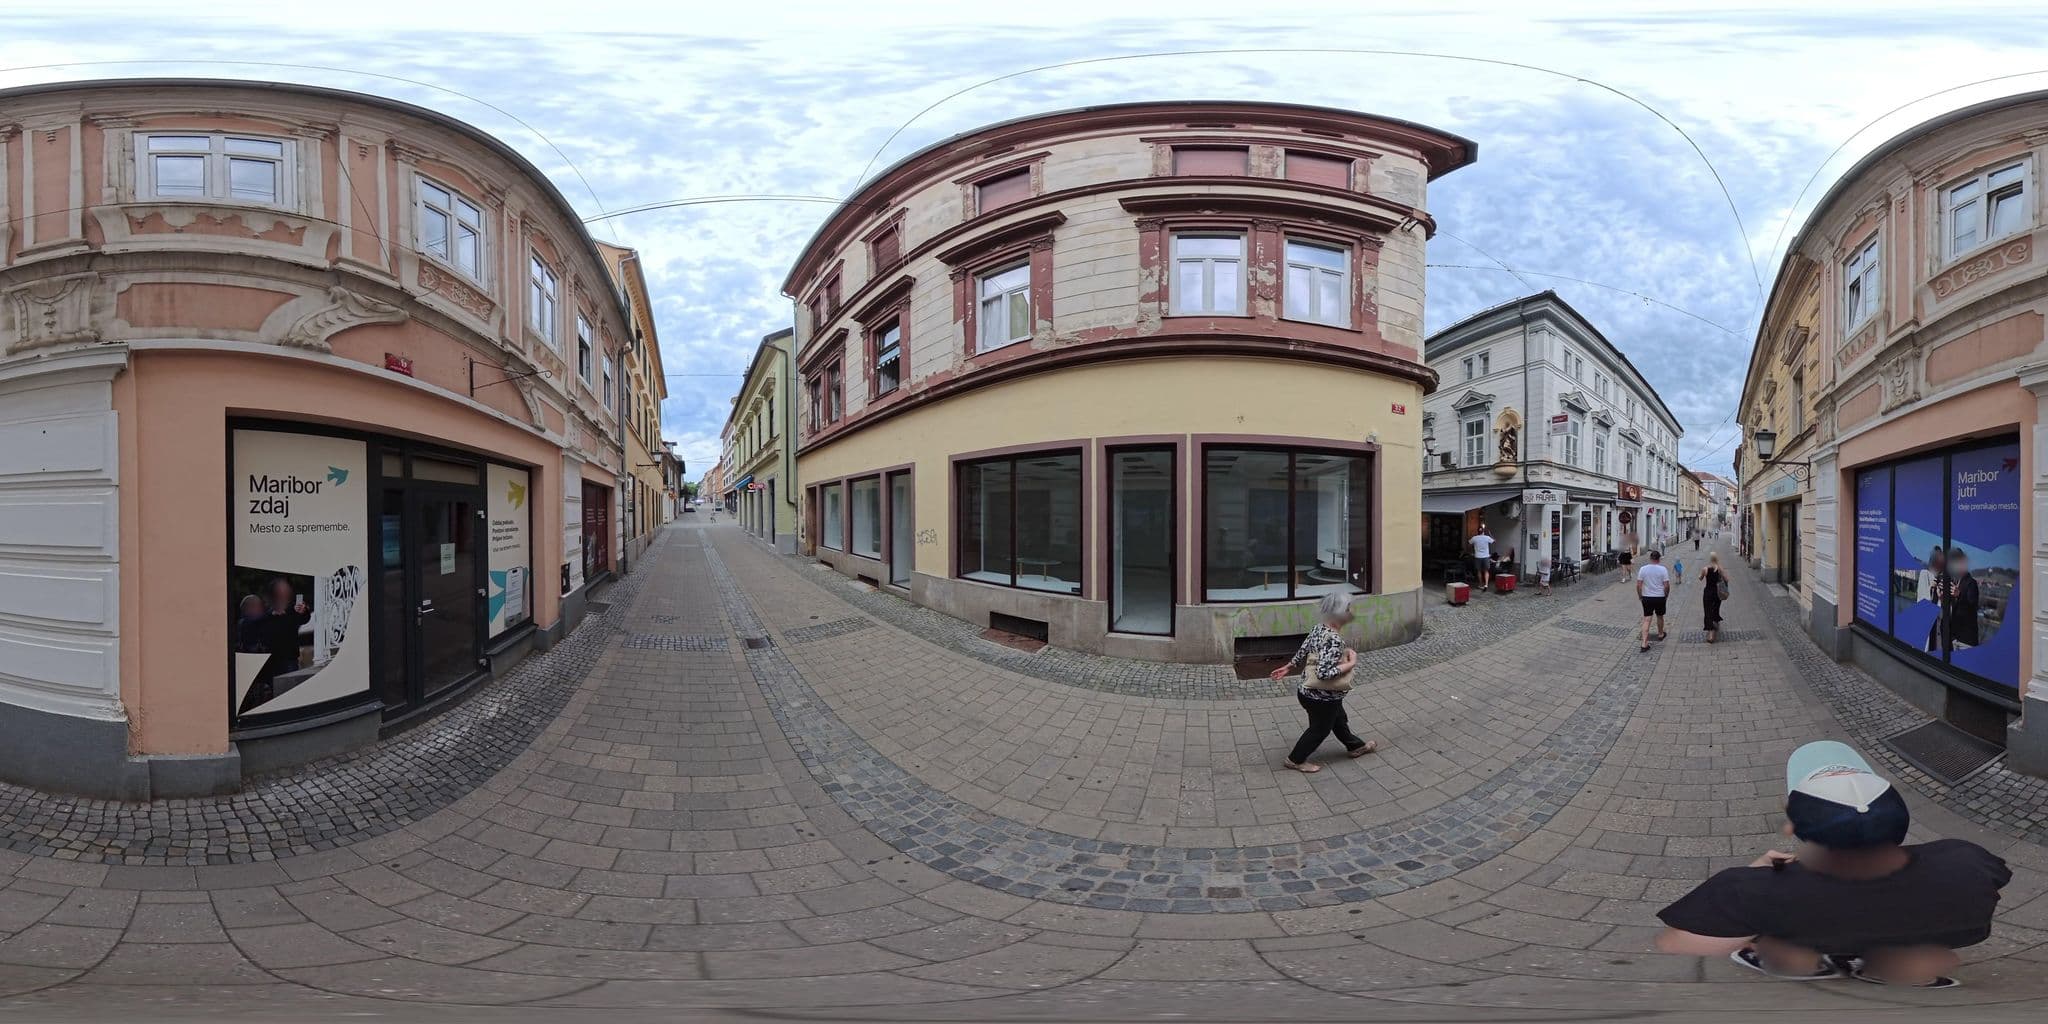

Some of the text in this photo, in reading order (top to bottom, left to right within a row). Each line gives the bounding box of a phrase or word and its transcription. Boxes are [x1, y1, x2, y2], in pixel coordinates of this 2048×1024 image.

[250, 474, 322, 494] Maribor
[1958, 469, 2000, 484] Maribor
[1957, 484, 1977, 501] jutri
[249, 496, 289, 518] zdaj
[250, 522, 350, 535] Mesto za spremembe.
